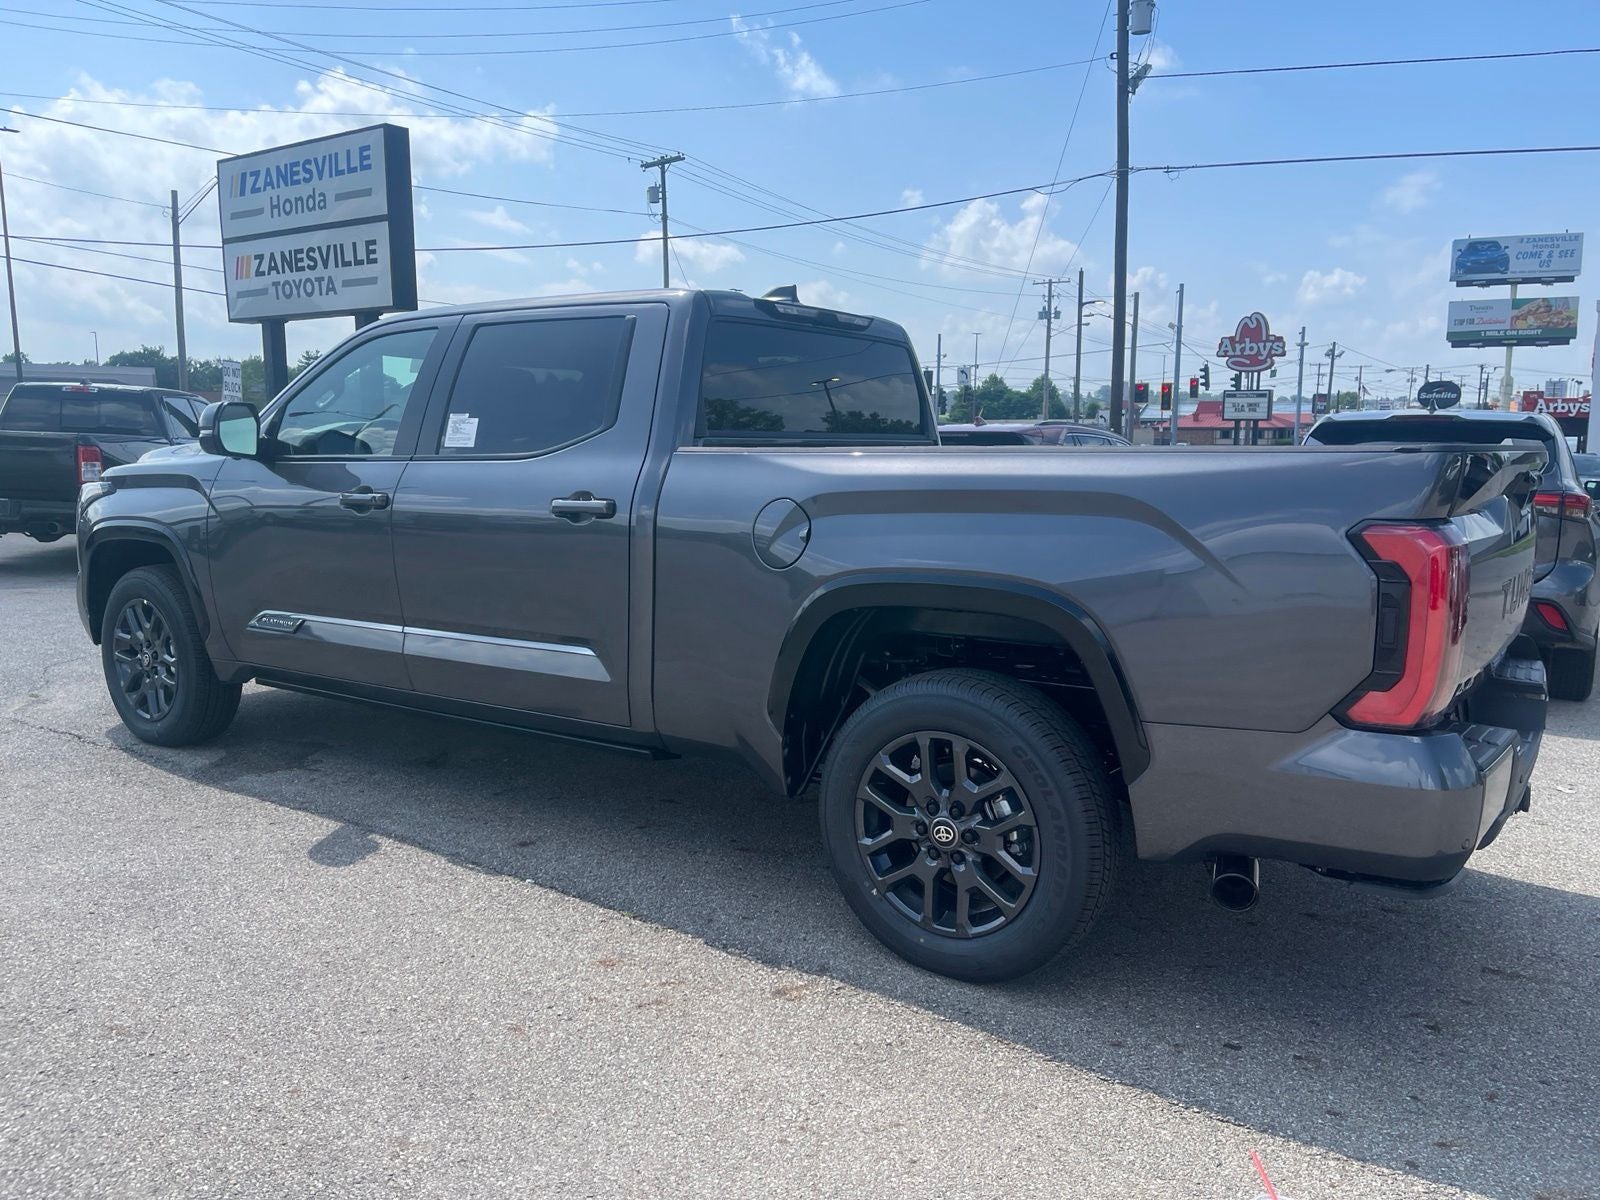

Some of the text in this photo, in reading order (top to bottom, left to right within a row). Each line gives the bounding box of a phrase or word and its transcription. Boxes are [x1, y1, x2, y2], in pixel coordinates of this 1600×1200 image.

[250, 145, 372, 194] ZANESVILLE
[269, 187, 327, 219] Honda
[1526, 235, 1580, 243] ZANESVILLE
[254, 239, 378, 277] ZANESVILLE
[1516, 249, 1577, 260] COME & SEE
[1538, 259, 1552, 268] US
[271, 275, 338, 300] TOYOTA
[1217, 336, 1284, 360] Arby's
[223, 366, 241, 378] DO NOT
[224, 381, 241, 393] BLOCK
[1534, 398, 1590, 417] Arby's
[262, 617, 294, 626] PLATINUM
